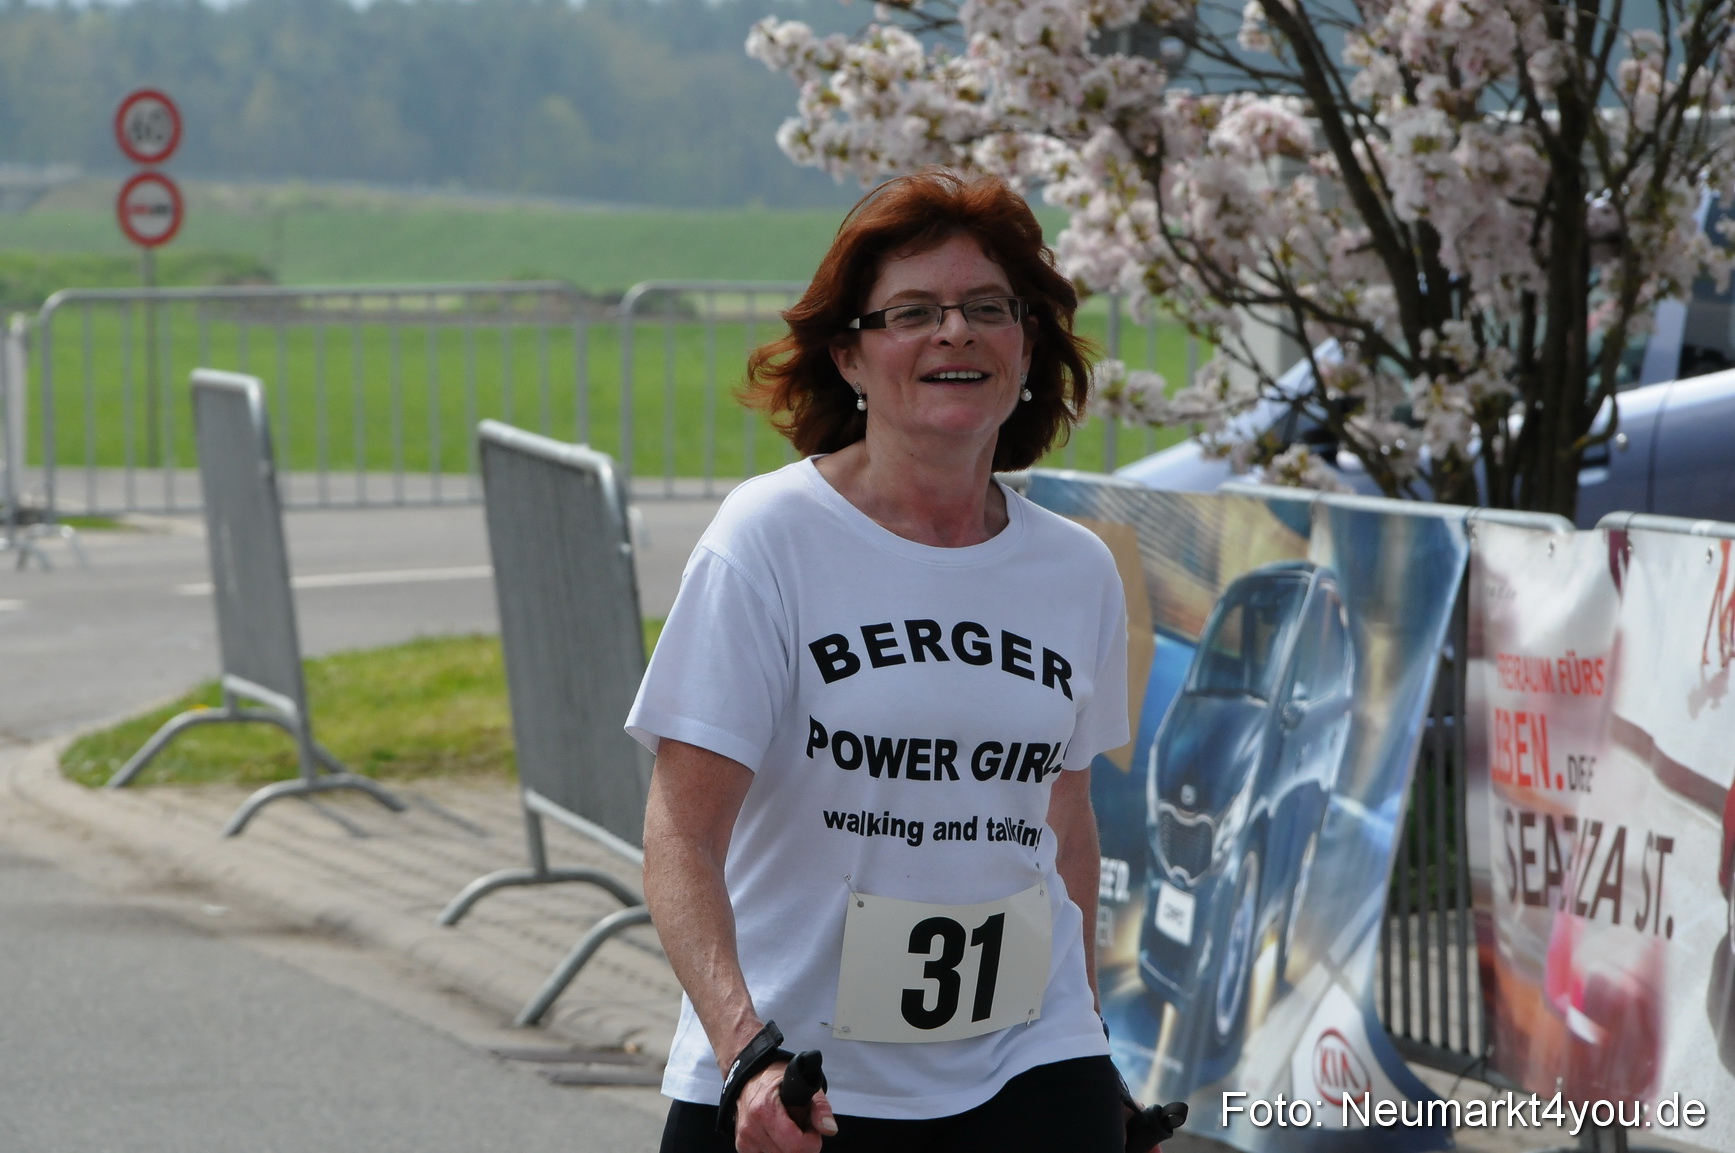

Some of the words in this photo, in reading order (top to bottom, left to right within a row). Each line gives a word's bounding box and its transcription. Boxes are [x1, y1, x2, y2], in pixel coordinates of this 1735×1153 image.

[808, 618, 1074, 702] BERGER
[1556, 649, 1605, 696] FÜRS
[806, 714, 960, 782] POWER
[823, 810, 925, 847] walking
[932, 815, 979, 841] and
[901, 912, 1006, 1030] 31
[1320, 1046, 1360, 1089] KIA
